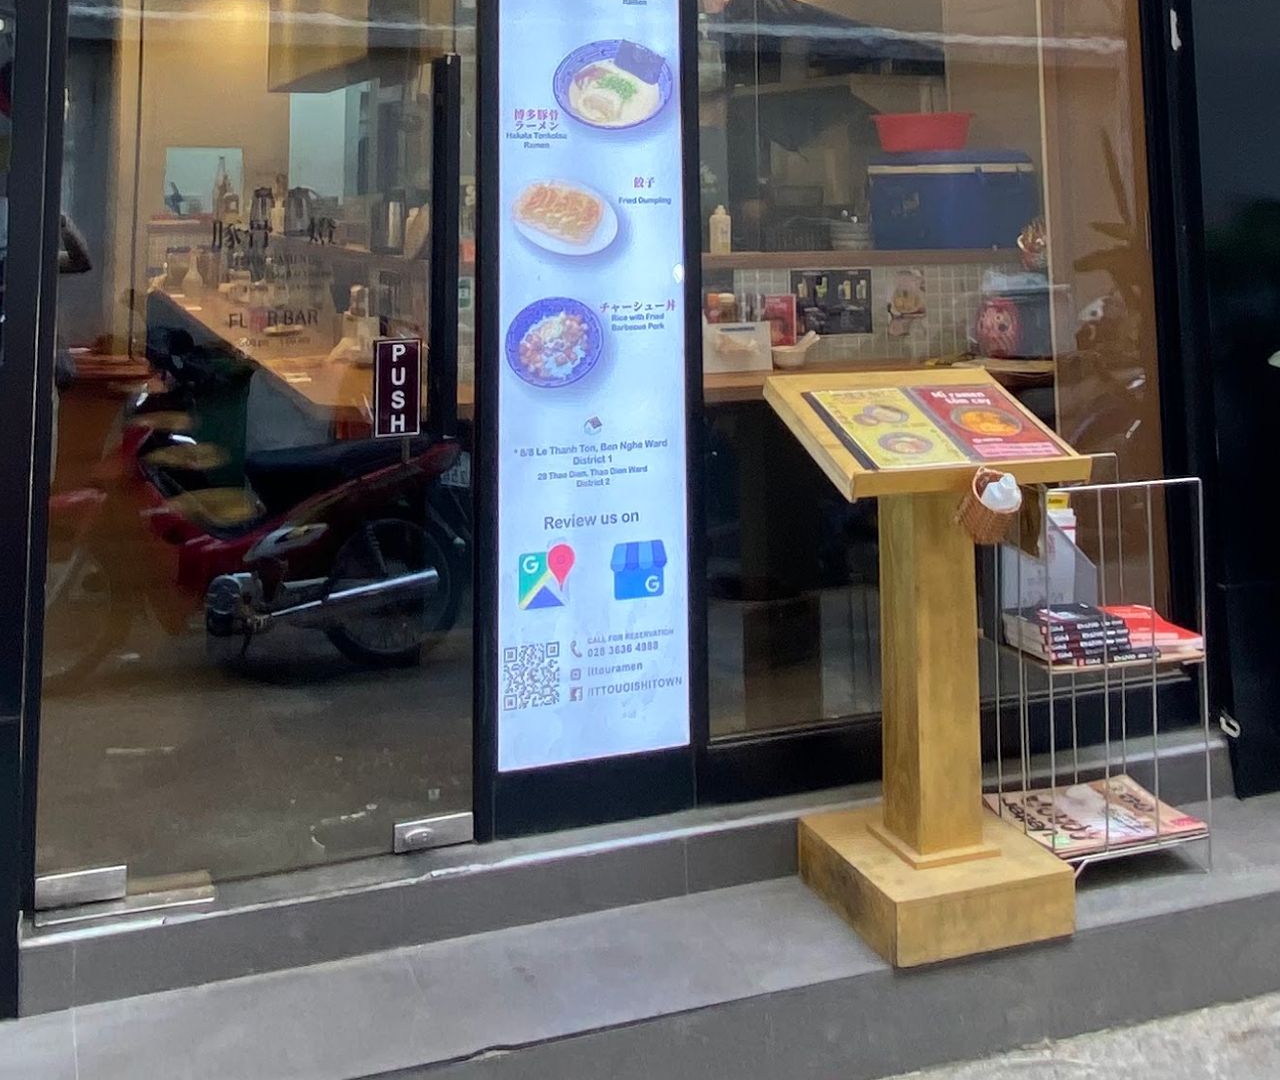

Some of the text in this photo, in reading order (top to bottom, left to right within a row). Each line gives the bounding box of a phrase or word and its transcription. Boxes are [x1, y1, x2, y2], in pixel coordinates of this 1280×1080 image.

[390, 344, 407, 433] PUSH
[549, 445, 577, 456] Thanh
[579, 444, 598, 454] Ton,
[600, 442, 618, 451] Ben
[620, 441, 643, 452] Nghe
[644, 438, 668, 448] Ward
[573, 455, 613, 465] District 1
[576, 477, 610, 488] District 2
[544, 511, 640, 530] Review us on
